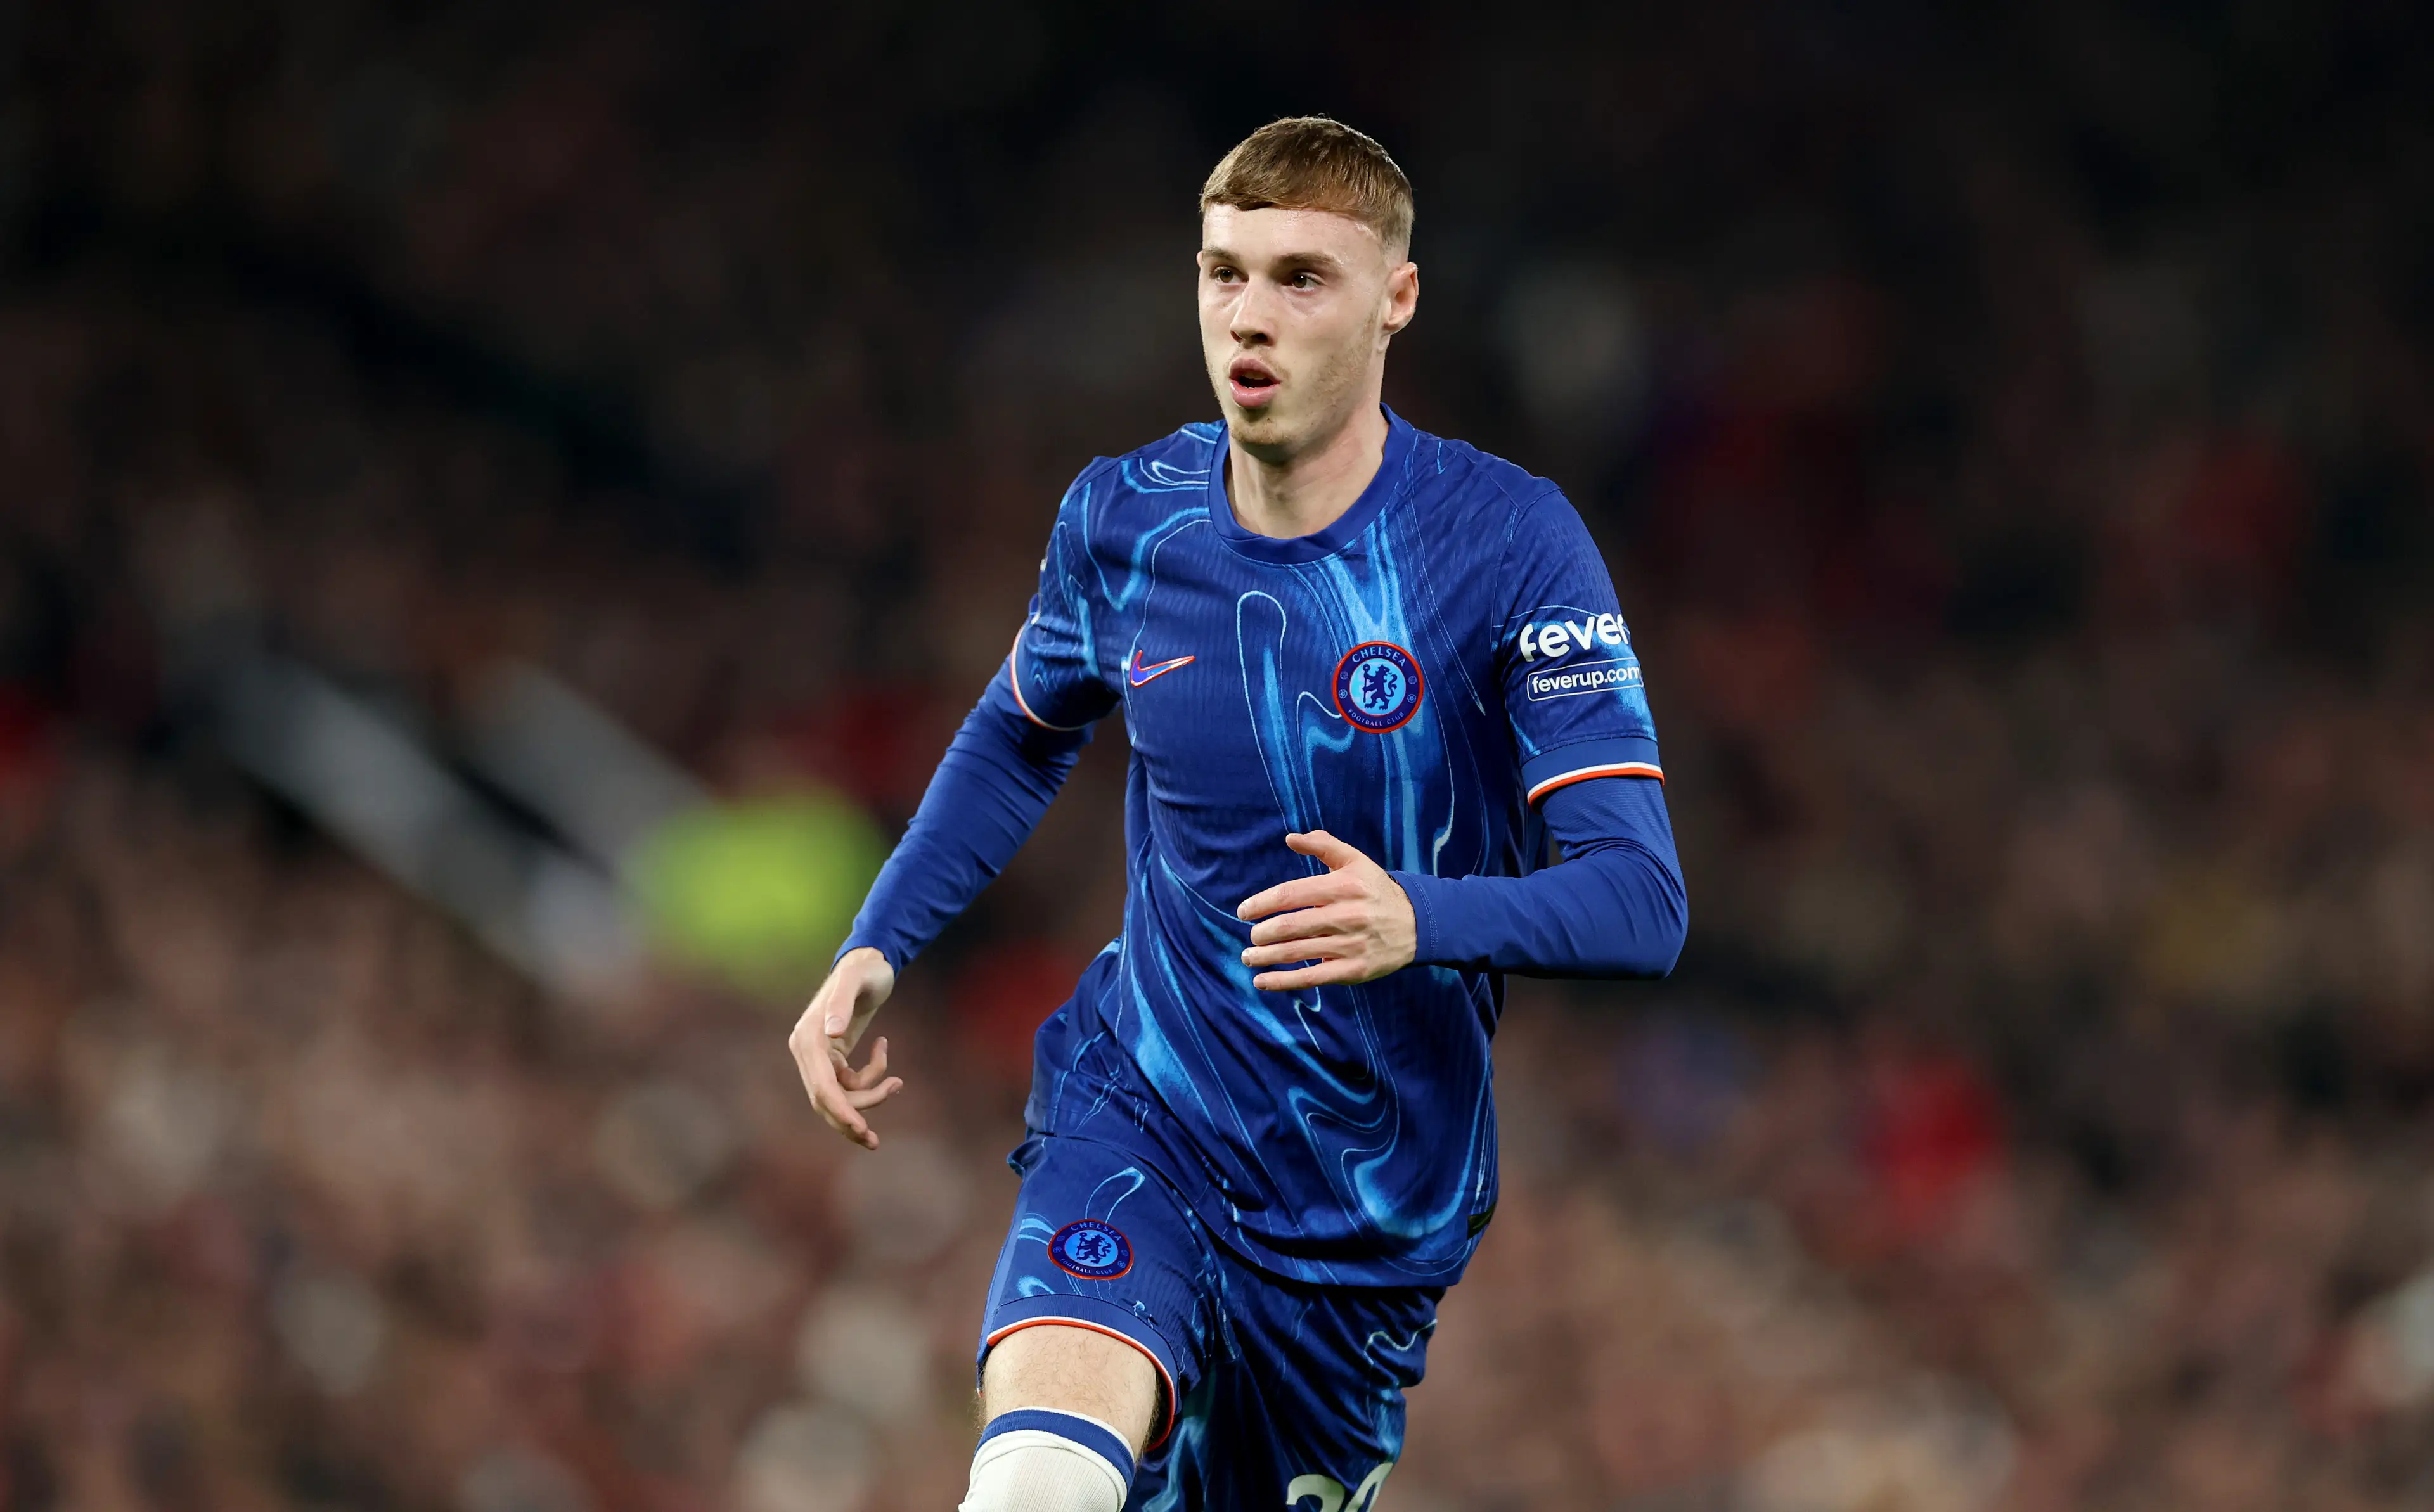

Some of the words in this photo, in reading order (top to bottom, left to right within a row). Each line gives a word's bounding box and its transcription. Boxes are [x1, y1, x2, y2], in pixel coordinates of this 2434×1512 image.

[1352, 646, 1407, 667] CHELSEA
[1532, 666, 1640, 694] feverup.com
[1348, 708, 1382, 726] FOOTBALL
[1386, 712, 1404, 724] CLUB
[1071, 1222, 1121, 1241] CHELSEA
[1060, 1258, 1091, 1274] FOOTBALL
